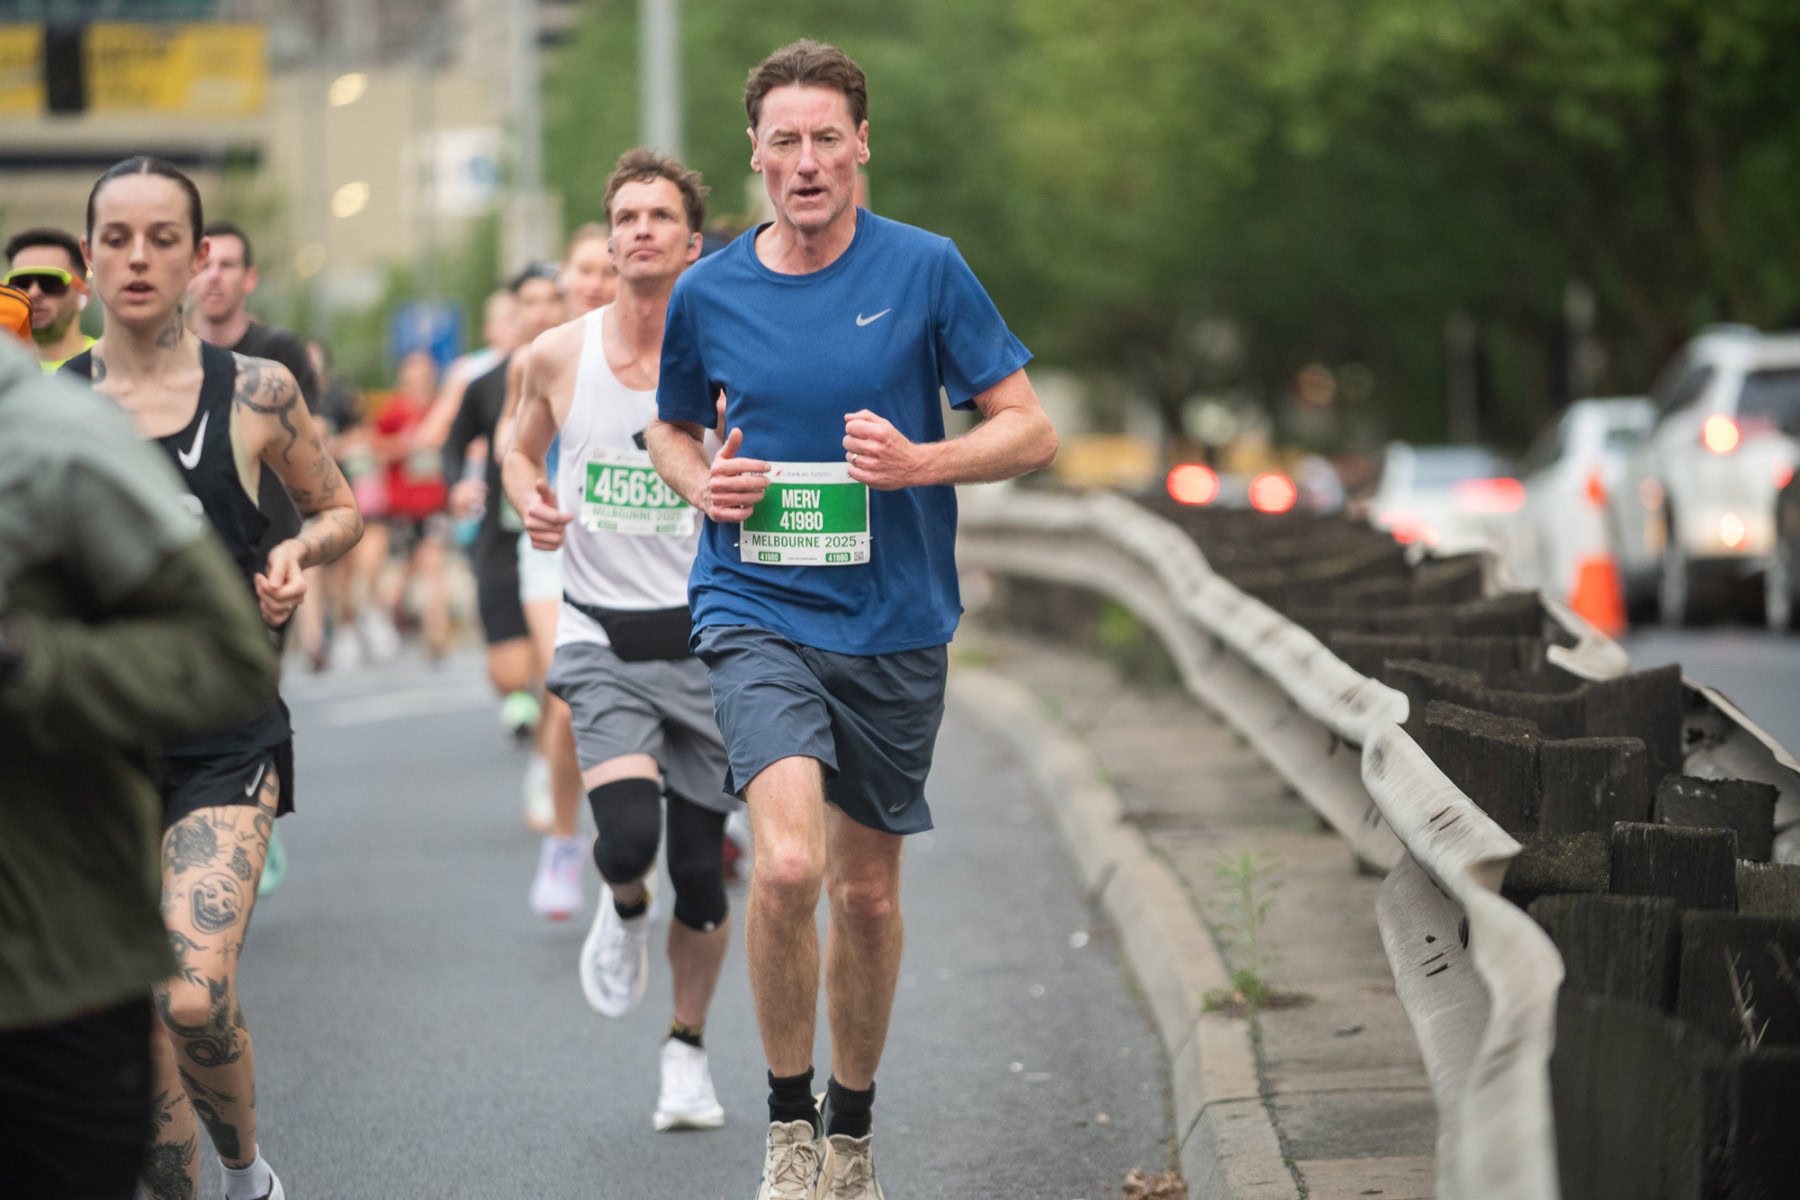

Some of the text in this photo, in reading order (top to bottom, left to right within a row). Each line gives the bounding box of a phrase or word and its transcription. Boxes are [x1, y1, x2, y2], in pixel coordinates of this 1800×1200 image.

[781, 488, 821, 509] MERV
[592, 506, 651, 520] MELBOURNE
[780, 511, 823, 531] 41980
[752, 535, 857, 548] MELBOURNE 2025
